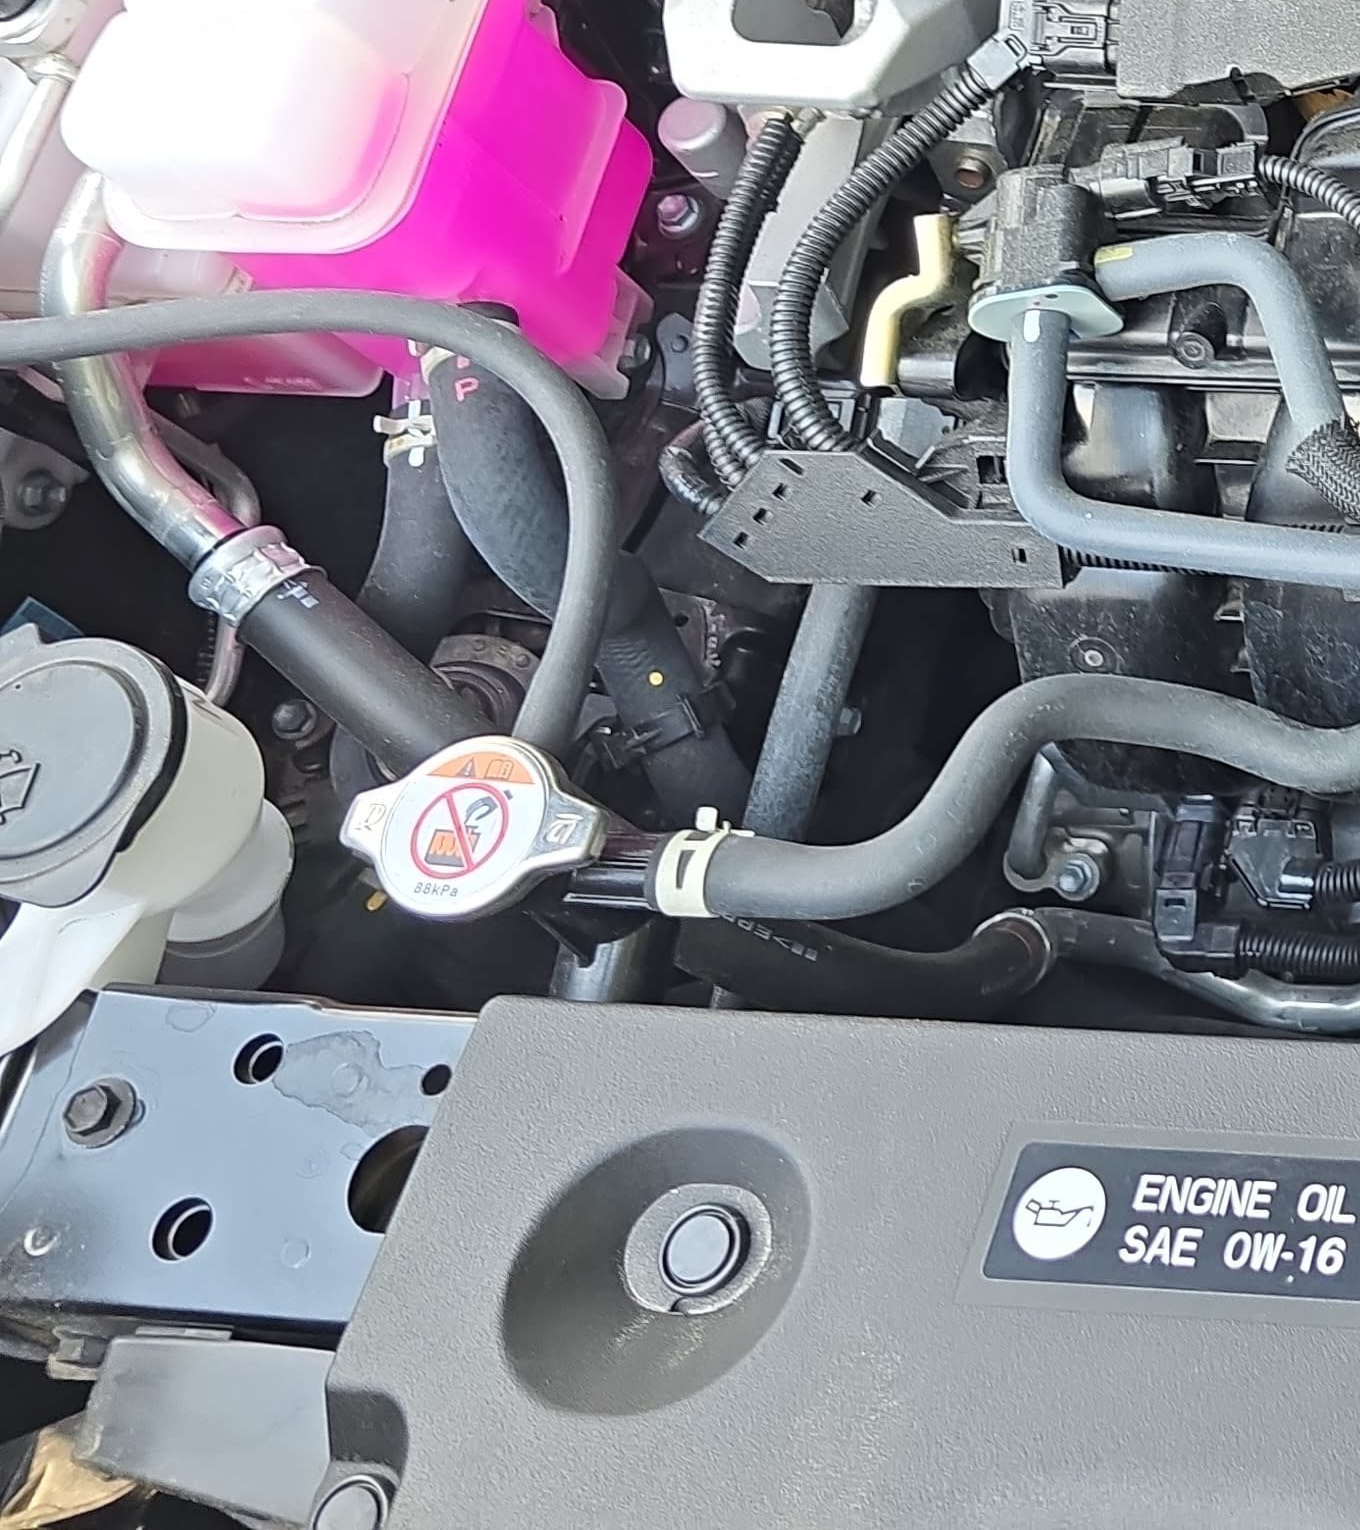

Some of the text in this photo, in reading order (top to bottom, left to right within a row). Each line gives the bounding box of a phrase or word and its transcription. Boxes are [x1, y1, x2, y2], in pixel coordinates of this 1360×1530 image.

[1132, 1174, 1357, 1224] ENGINE OIL
[1118, 1224, 1348, 1276] SAE 0W-16
